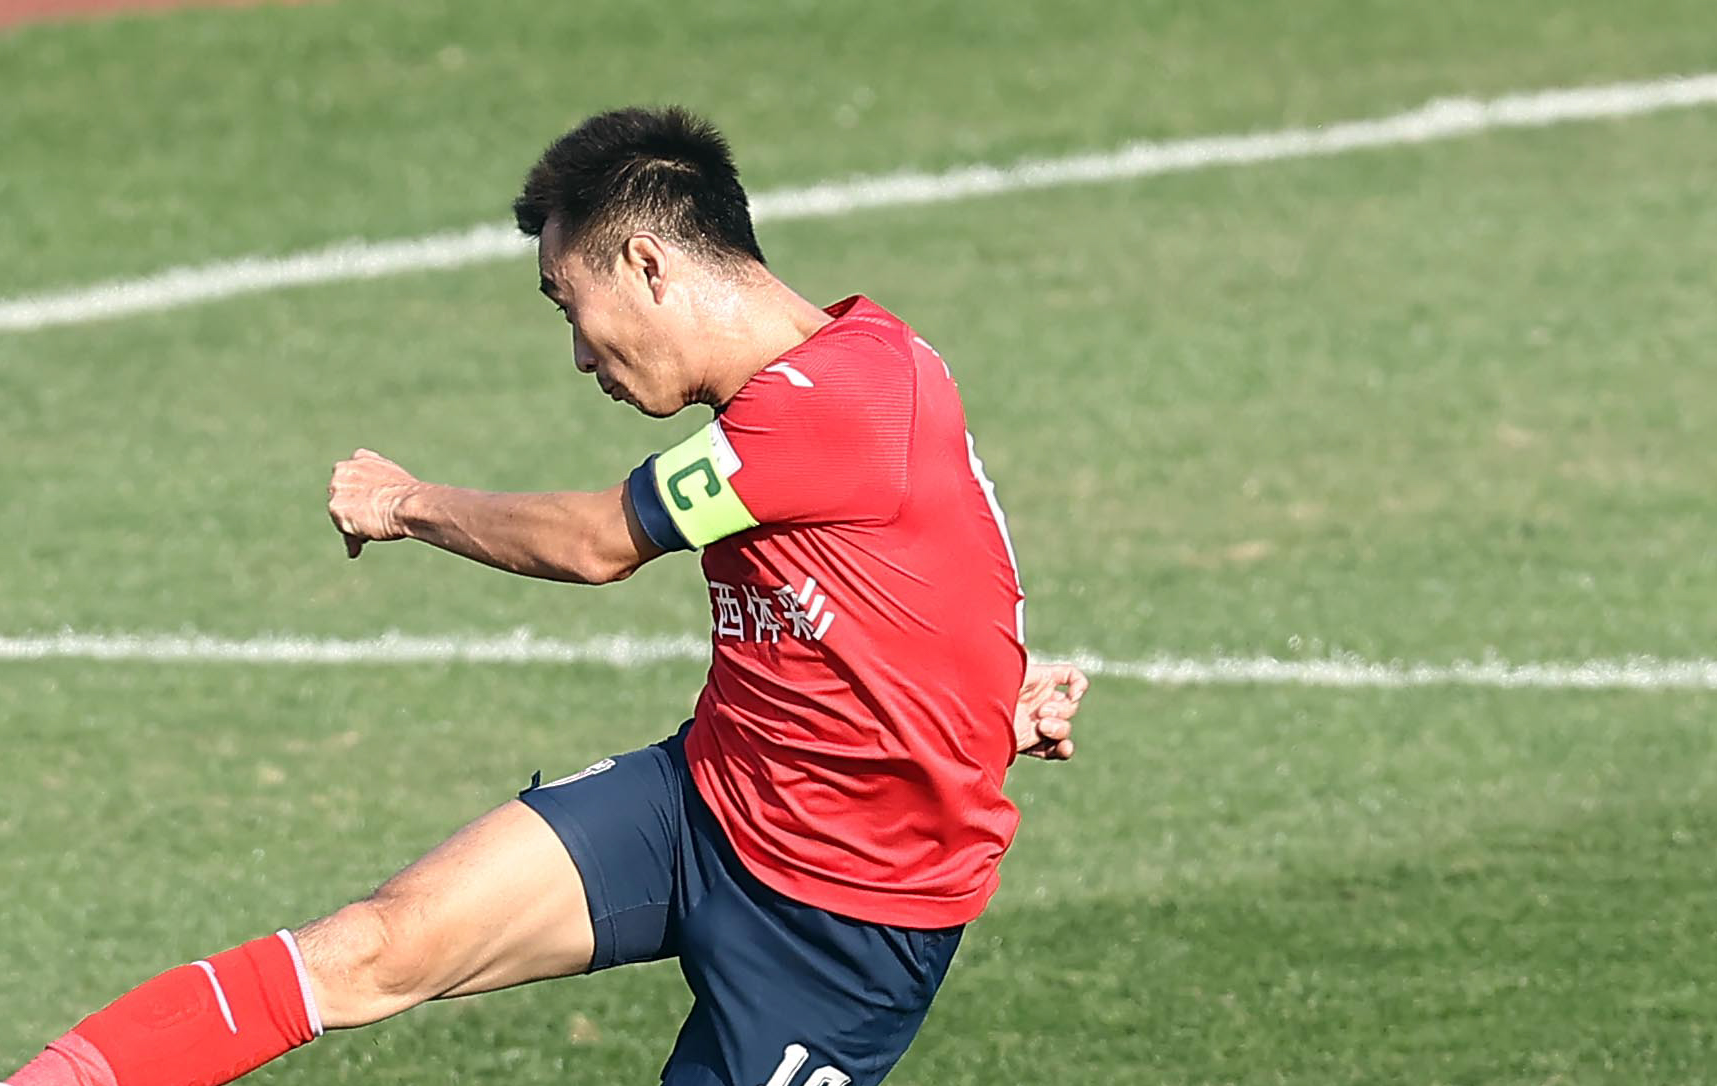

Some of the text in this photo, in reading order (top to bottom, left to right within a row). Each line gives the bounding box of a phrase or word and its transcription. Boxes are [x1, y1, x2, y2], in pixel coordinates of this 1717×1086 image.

[667, 457, 721, 511] C
[709, 575, 835, 644] 西体彩
